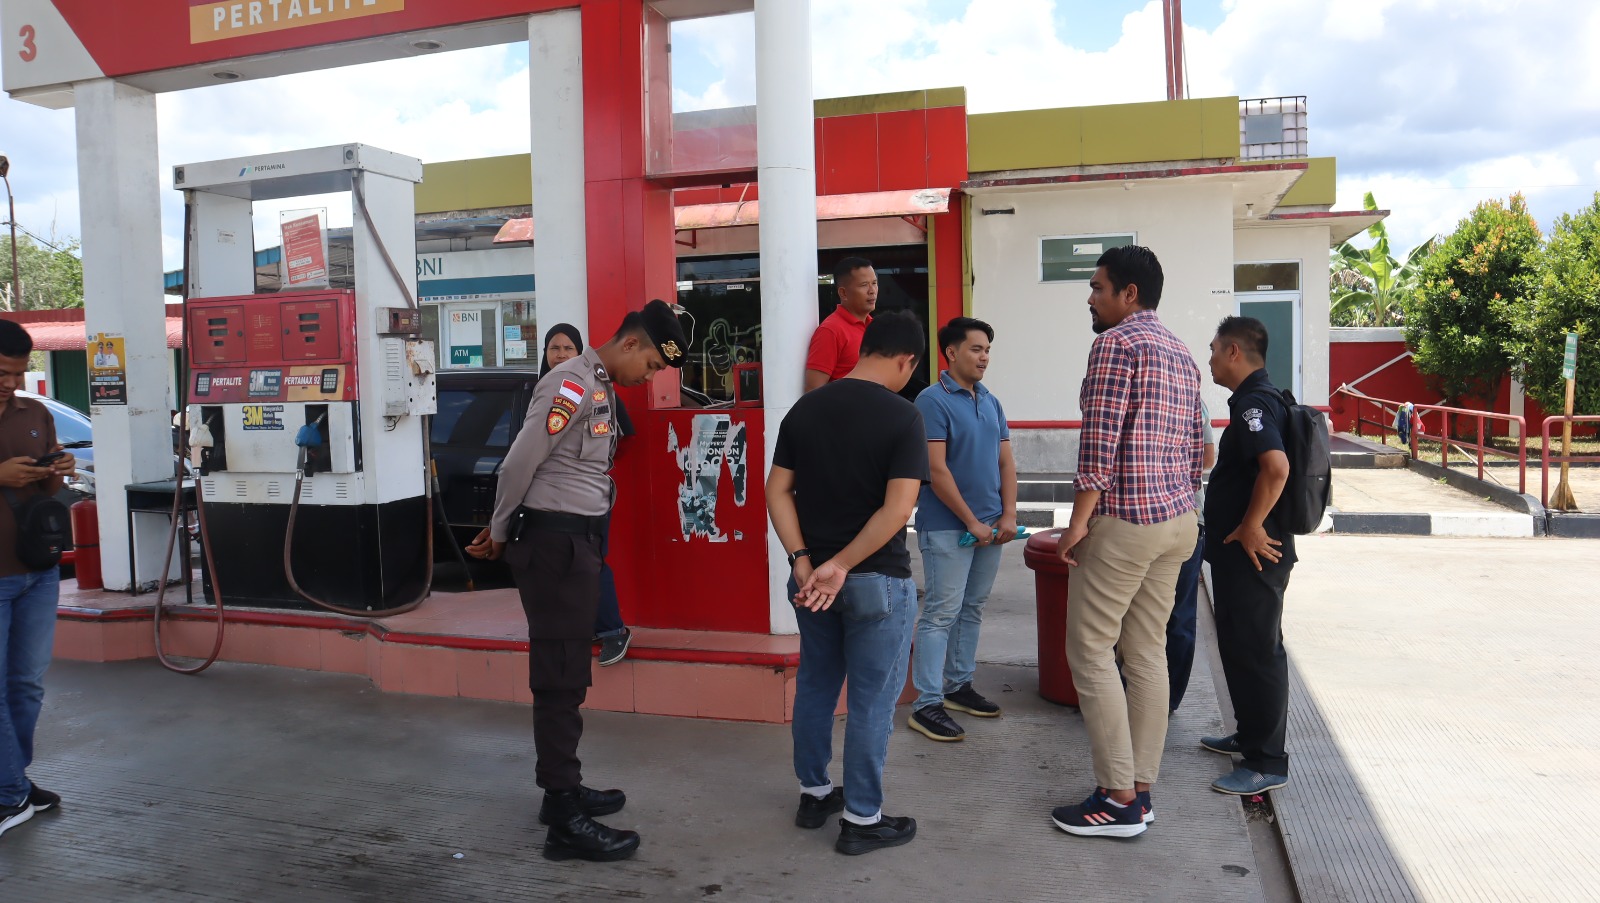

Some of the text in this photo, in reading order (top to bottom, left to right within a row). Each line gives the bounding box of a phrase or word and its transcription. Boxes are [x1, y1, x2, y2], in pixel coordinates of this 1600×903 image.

[214, 0, 376, 31] PERTALI
[18, 24, 36, 62] 3
[254, 163, 286, 172] PERTAMINA
[462, 312, 478, 322] BNI
[212, 376, 242, 386] PERTALITE
[250, 370, 264, 392] 3M
[284, 376, 321, 385] PERTAMAX 92
[244, 406, 263, 426] 3M
